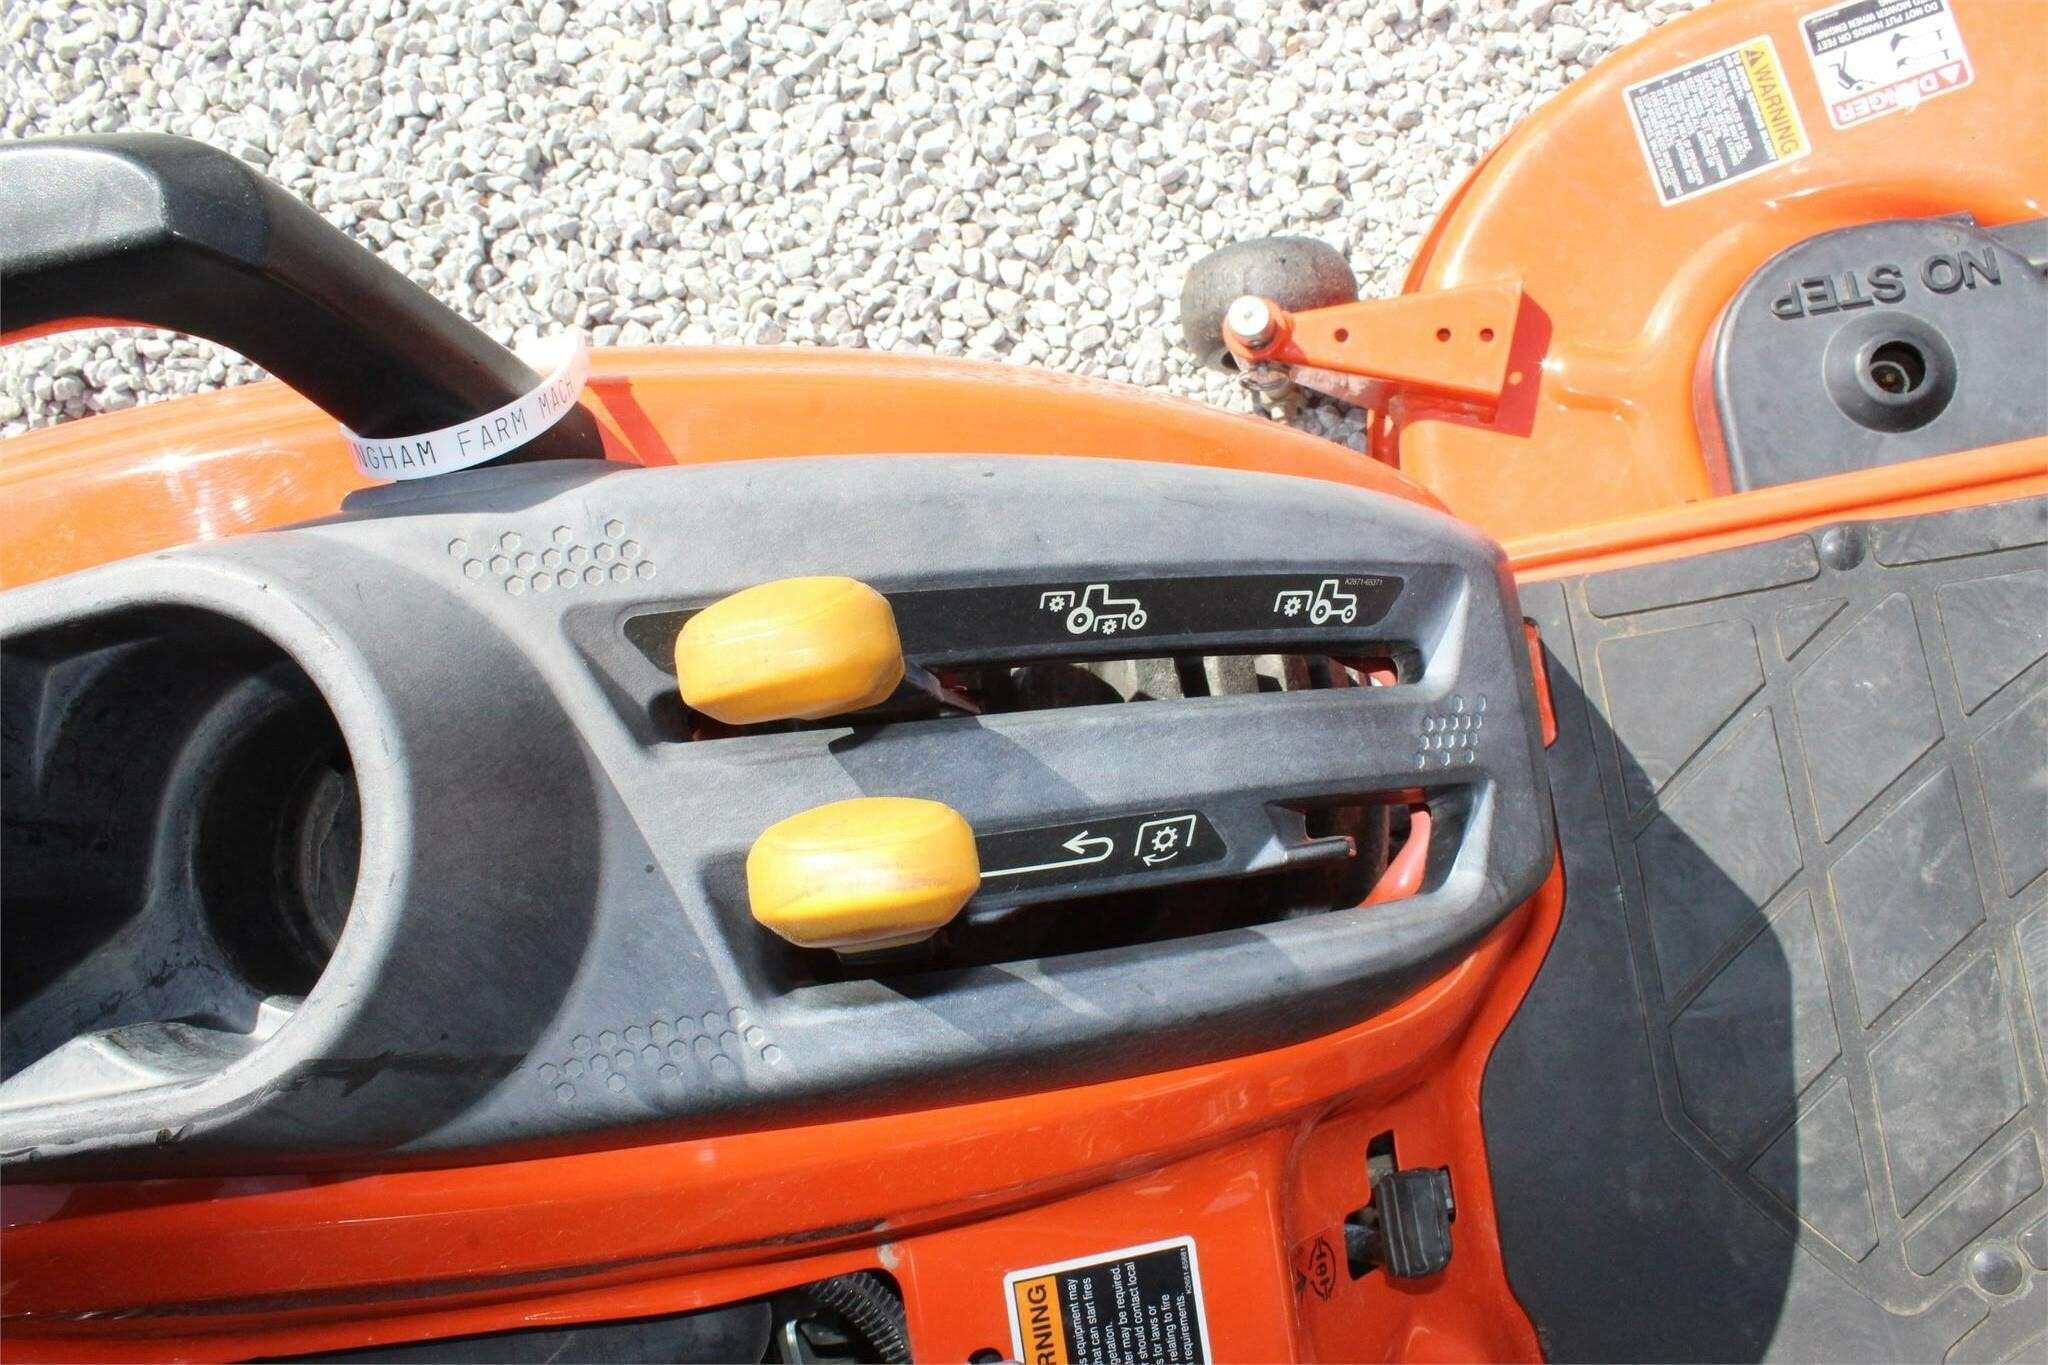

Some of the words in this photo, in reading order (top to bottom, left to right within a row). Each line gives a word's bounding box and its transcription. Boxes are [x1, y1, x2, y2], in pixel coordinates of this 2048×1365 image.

[1905, 6, 1923, 20] NOT
[1924, 2, 1938, 13] DO
[1885, 14, 1903, 27] PUT
[1837, 32, 1851, 43] OR
[1753, 64, 1800, 154] WARNING
[1920, 248, 2001, 294] NO
[1771, 264, 1906, 320] STEP
[353, 440, 437, 469] NGHAM
[457, 407, 528, 456] FARM
[1112, 1265, 1125, 1307] required.
[1125, 1262, 1138, 1288] local
[1067, 1279, 1078, 1299] may
[1083, 1277, 1093, 1299] fires
[1087, 1301, 1098, 1324] start
[1131, 1291, 1143, 1323] contact
[1148, 1305, 1157, 1315] or
[1161, 1294, 1170, 1311] fire
[1118, 1311, 1128, 1326] be
[1163, 1312, 1173, 1321] to
[1176, 1293, 1193, 1361] requirements.
[1069, 1304, 1086, 1356] equipment
[1090, 1326, 1100, 1345] can
[1121, 1327, 1131, 1348] may
[1150, 1317, 1160, 1341] laws
[1134, 1325, 1148, 1360] should
[1153, 1343, 1163, 1357] for
[1165, 1324, 1178, 1361] relating
